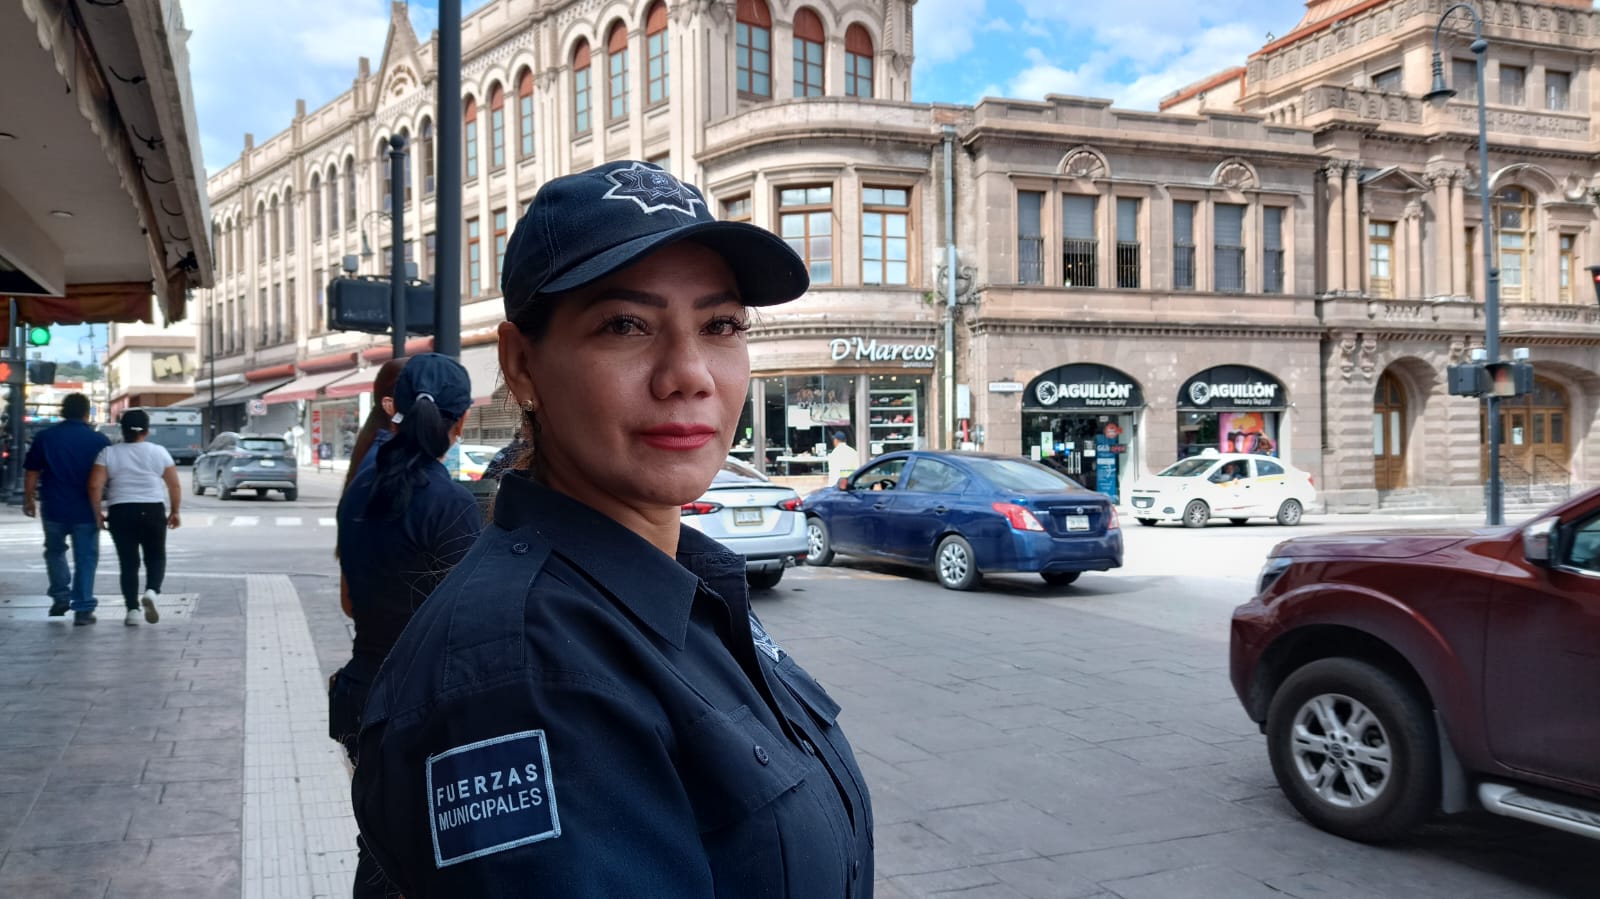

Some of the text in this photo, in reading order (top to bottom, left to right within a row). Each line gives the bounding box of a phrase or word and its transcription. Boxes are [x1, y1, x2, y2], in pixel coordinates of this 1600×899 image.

[829, 337, 936, 361] D'Marcos
[1058, 382, 1130, 398] AGUILLÓN
[1209, 382, 1275, 398] AGUILLÓN
[436, 763, 538, 807] FUERZAS
[438, 787, 543, 832] MUNICIPALES
